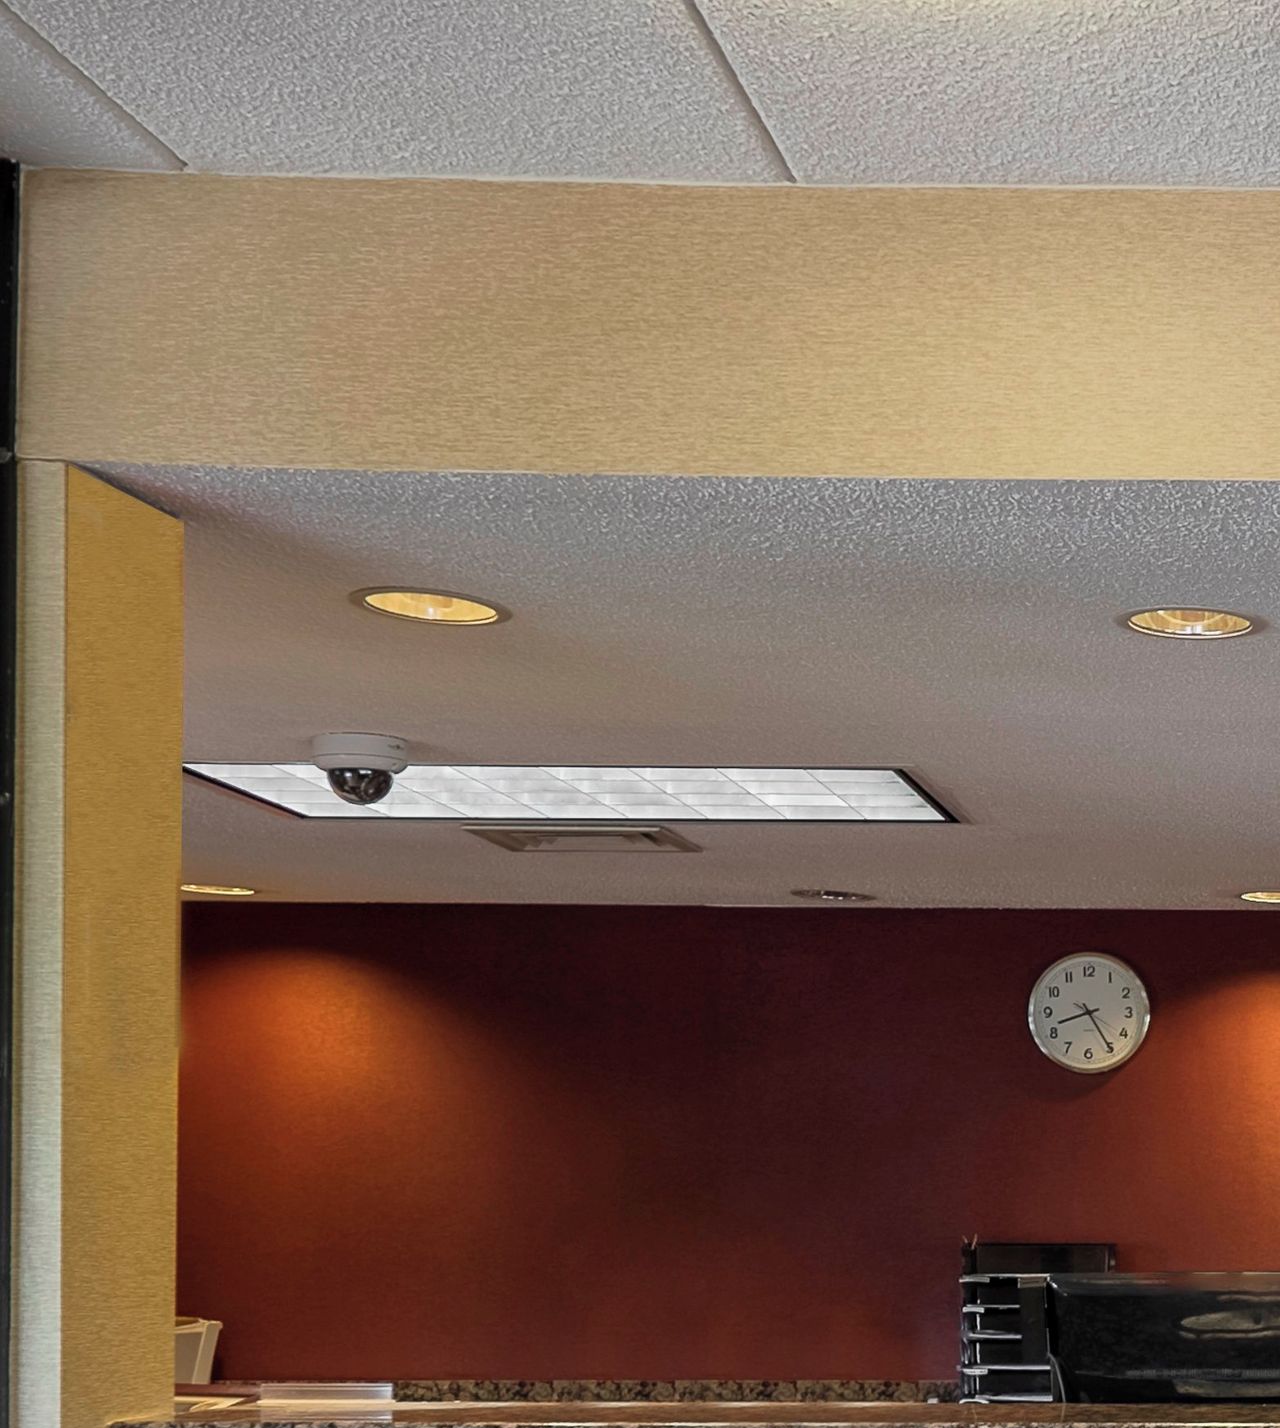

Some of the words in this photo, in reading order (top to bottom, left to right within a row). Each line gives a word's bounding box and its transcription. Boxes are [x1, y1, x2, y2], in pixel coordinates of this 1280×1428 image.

[1065, 971, 1073, 983] 11
[1083, 966, 1096, 977] 12
[1107, 971, 1113, 983] 1
[1048, 986, 1060, 998] 10
[1121, 987, 1131, 999] 2
[1043, 1006, 1053, 1018] 9
[1124, 1007, 1133, 1019] 3
[1049, 1027, 1058, 1039] 8
[1119, 1027, 1128, 1039] 4
[1064, 1042, 1073, 1054] 7
[1084, 1048, 1093, 1059] 6
[1106, 1042, 1114, 1053] 5
